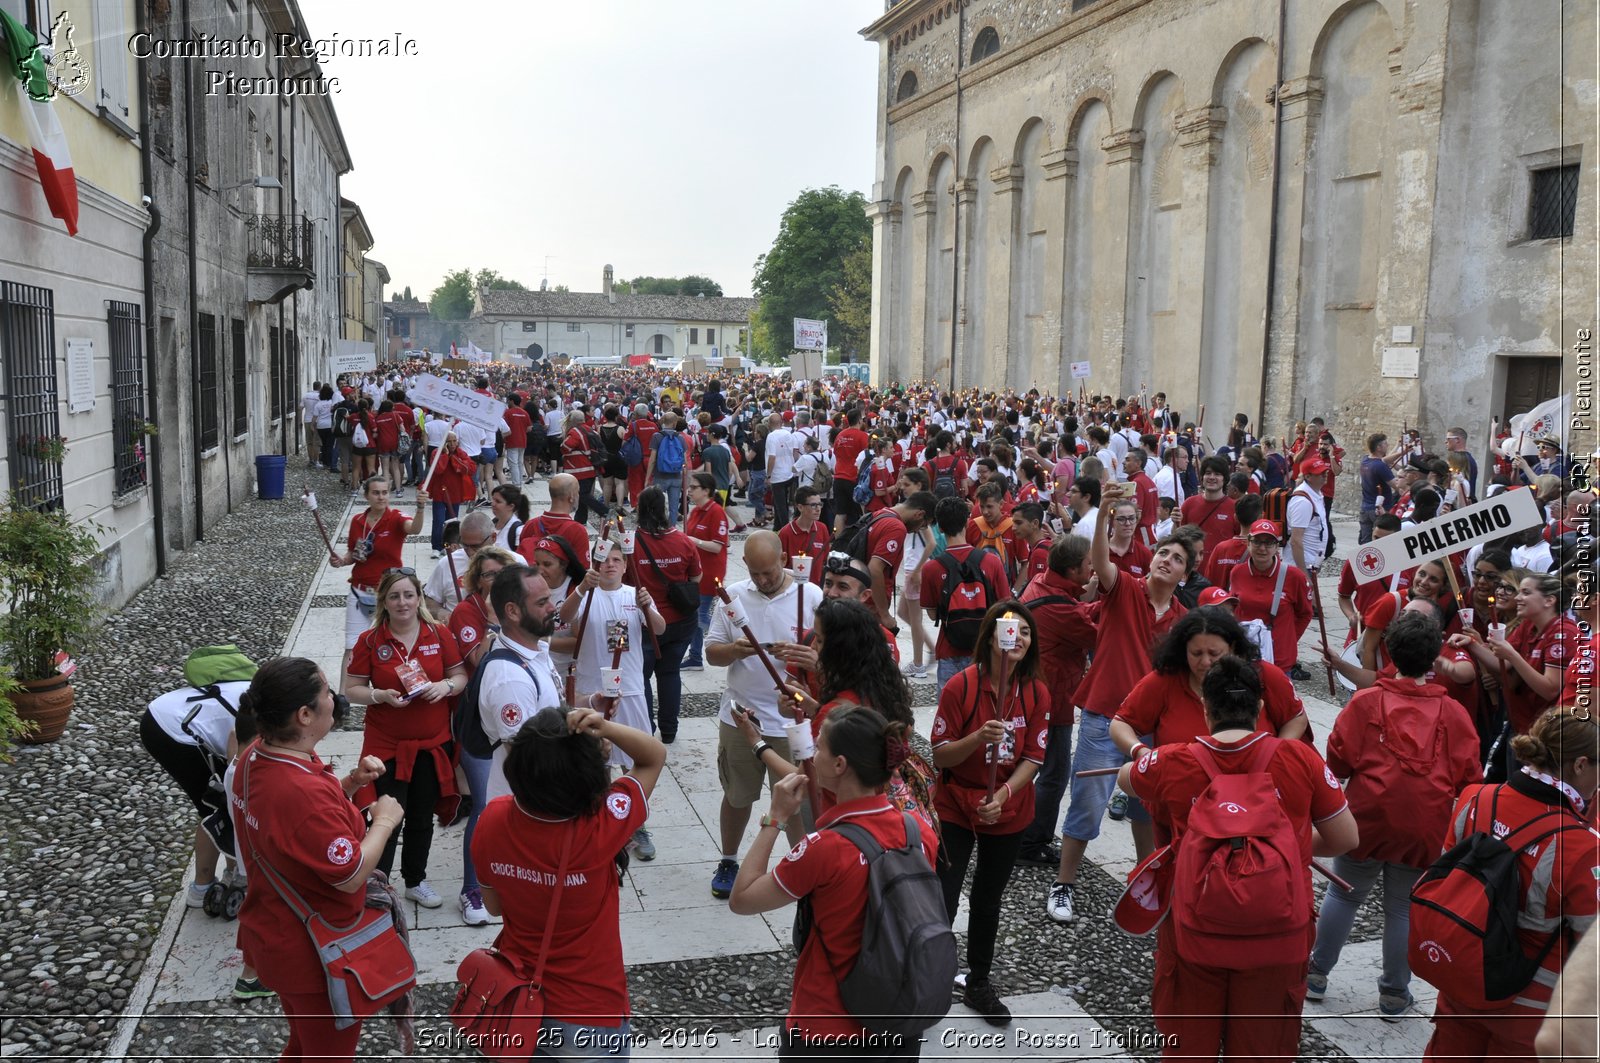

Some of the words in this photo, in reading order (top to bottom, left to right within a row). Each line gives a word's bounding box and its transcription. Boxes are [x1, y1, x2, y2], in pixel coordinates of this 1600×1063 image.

[800, 329, 819, 338] PRATO
[441, 388, 480, 409] CENTO
[1403, 503, 1512, 560] PALERMO
[490, 862, 517, 878] CROCE
[517, 866, 542, 885] ROSSA
